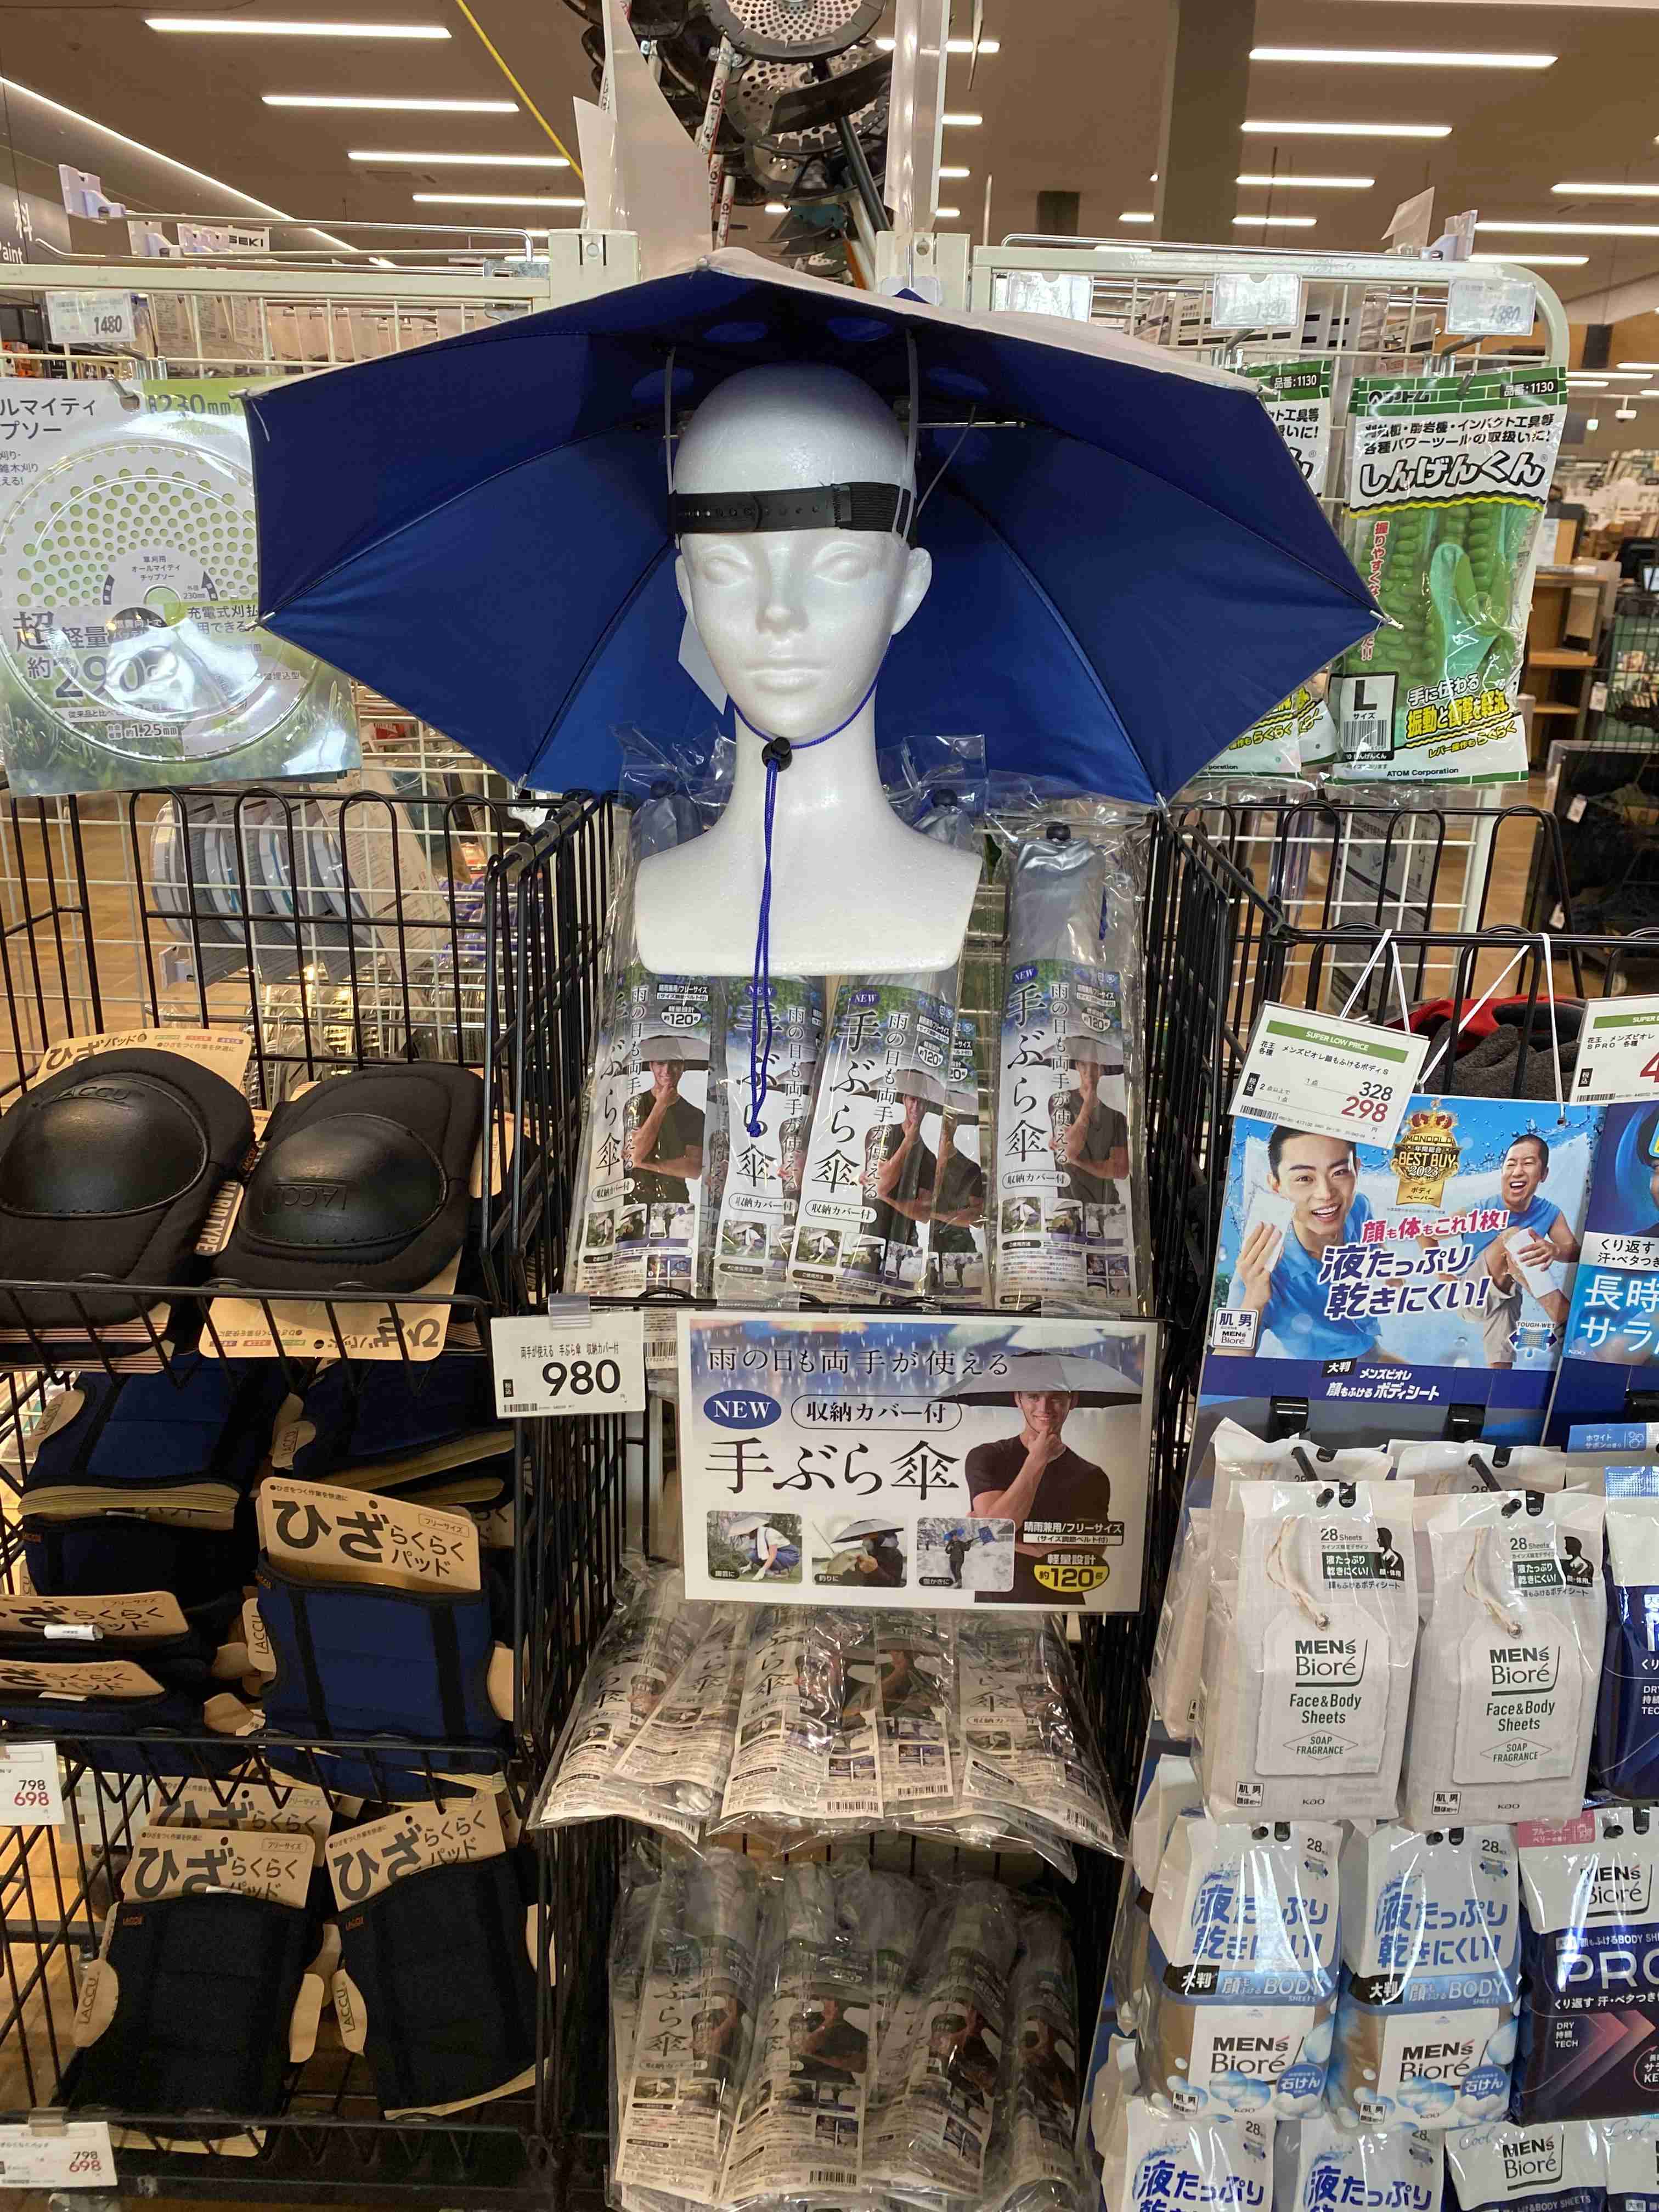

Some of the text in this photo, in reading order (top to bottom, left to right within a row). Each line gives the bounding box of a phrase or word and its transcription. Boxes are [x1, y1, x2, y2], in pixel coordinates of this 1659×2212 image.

[93, 315, 122, 334] 1480
[1504, 381, 1554, 397] 品番:1130
[1360, 450, 1543, 496] しんげんくん
[1353, 680, 1378, 711] L
[1412, 767, 1459, 776] Corporation
[1014, 968, 1035, 981] NEW
[854, 993, 877, 1003] NEW
[1306, 1030, 1369, 1052] SUPER LOW PRICE
[1005, 983, 1048, 1163] 手ぶら傘
[1358, 1081, 1393, 1102] 328
[811, 1010, 882, 1193] 手ぶら傘
[1341, 1096, 1388, 1122] 298
[1404, 1135, 1453, 1144] MONOQLO
[1399, 1151, 1457, 1168] BEST BUY
[1007, 1171, 1065, 1185] 収納カバー付
[1408, 1165, 1439, 1177] 2023
[735, 1195, 792, 1211] 収納カバー付
[811, 1202, 871, 1220] 収納カバー付
[196, 1219, 226, 1251] TYPE
[1362, 1210, 1509, 1244] 顔も体もこれ1枚!
[1600, 1238, 1655, 1254] くり返す
[1318, 1244, 1471, 1284] 液たっぷり
[1324, 1278, 1491, 1319] 乾きにくい!
[1584, 1274, 1659, 1314] 長時
[1220, 1313, 1252, 1327] 肌 男
[1517, 1321, 1556, 1329] TOUGH-WET
[708, 1346, 1010, 1378] 雨の日も両手が使える
[1327, 1361, 1352, 1374] 大判
[542, 1358, 621, 1397] 980
[1359, 1368, 1413, 1382] メンズビオレ
[713, 1400, 771, 1420] NEW
[805, 1401, 948, 1425] 収納カバー付
[704, 1437, 961, 1501] 手ぶら傘
[272, 1499, 390, 1563] ひざ
[425, 1517, 463, 1533] フリーサイズ
[1321, 1528, 1338, 1541] 28
[391, 1525, 465, 1562] らくらく
[1509, 1537, 1527, 1551] 28
[391, 1549, 450, 1577] パッド
[1326, 1555, 1365, 1565] 液たっぷり
[1326, 1566, 1369, 1576] 乾きにくい!
[1516, 1564, 1553, 1574] 液たっぷり
[1517, 1574, 1557, 1585] 乾きにくい!
[74, 1606, 165, 1621] らくらく
[252, 1614, 269, 1655] LACCU
[1295, 1655, 1357, 1676] Bioré
[1491, 1663, 1550, 1685] Bioré
[1289, 1693, 1362, 1711] Face&Body
[1486, 1700, 1555, 1716] Face&Body
[1301, 1710, 1347, 1724] Sheets
[1497, 1717, 1541, 1732] Sheets
[1310, 1736, 1333, 1745] SOAP
[1506, 1742, 1528, 1752] SOAP
[1296, 1746, 1344, 1755] FRAGRANCE
[1493, 1752, 1538, 1763] FRAGRANCE
[19, 1779, 46, 1791] 798
[13, 1791, 50, 1807] 698
[424, 1809, 487, 1848] らくらく
[1306, 1837, 1323, 1853] 28
[1481, 1839, 1499, 1853] 28
[134, 1847, 235, 1898] ひざ
[232, 1857, 298, 1879] らくらく
[78, 1977, 98, 2025] LACCU
[1554, 1991, 1659, 2010] くり返す 汗・ベタつき
[1556, 2021, 1575, 2030] DRY
[1555, 2040, 1579, 2049] TECH
[1211, 2052, 1287, 2074] Bioré
[1400, 2057, 1471, 2083] Bioré
[1281, 2077, 1320, 2090] 石けん
[1465, 2077, 1504, 2094] 石けん
[1245, 2121, 1261, 2136] 28
[74, 2151, 98, 2160] 798
[69, 2159, 102, 2172] 698
[1504, 2152, 1557, 2179] Bioré
[1307, 2165, 1432, 2210] 液たっぷり
